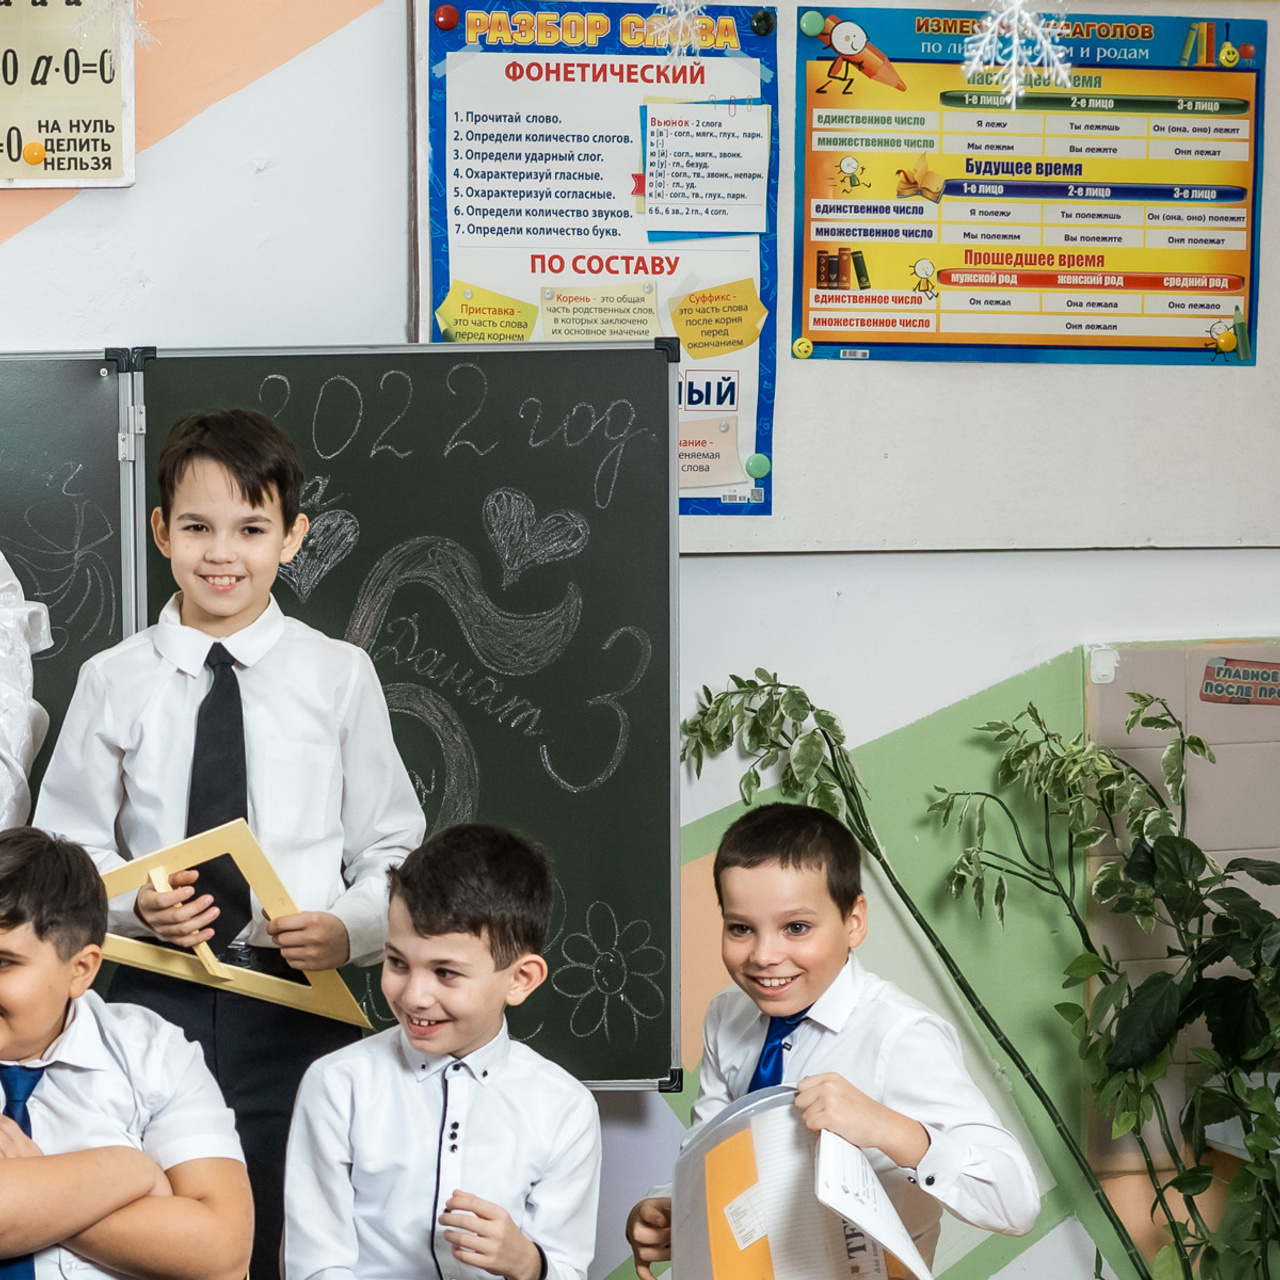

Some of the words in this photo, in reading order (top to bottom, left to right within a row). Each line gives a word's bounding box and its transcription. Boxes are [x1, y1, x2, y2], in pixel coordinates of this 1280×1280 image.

[465, 10, 610, 46] РАЗБОР
[1096, 45, 1150, 61] родам
[505, 60, 706, 86] ФОНЕТИЧЕСКИЙ
[1070, 97, 1087, 108] 2-е
[1088, 98, 1115, 110] лицо
[1177, 100, 1193, 111] 3-е
[1194, 101, 1220, 112] лицо
[454, 111, 464, 123] 1.
[465, 111, 521, 125] Прочитай
[525, 114, 562, 124] слово.
[650, 117, 690, 127] Вьюнок
[701, 120, 722, 128] слога
[817, 113, 892, 126] единственное
[894, 115, 926, 126] число
[38, 119, 62, 133] НА
[69, 119, 115, 133] НУЛЬ
[453, 130, 463, 142] 2.
[465, 130, 522, 144] Определи
[525, 132, 590, 143] количество
[592, 133, 633, 144] слогов.
[817, 136, 902, 148] множественное
[903, 138, 935, 149] число
[44, 138, 112, 154] ДЕЛИТЬ
[453, 149, 463, 161] 3.
[465, 149, 522, 163] Определи
[524, 150, 575, 164] ударный
[577, 152, 604, 162] слог.
[43, 157, 112, 171] НЕЛЬЗЯ
[965, 157, 1033, 176] Будущее
[1035, 162, 1083, 177] время
[453, 168, 463, 179] 4.
[465, 167, 552, 182] Охарактеризуй
[554, 171, 604, 181] гласные.
[453, 186, 463, 198] 5.
[465, 186, 552, 201] Охарактеризуй
[554, 190, 616, 200] согласные.
[962, 182, 977, 194] 1-е
[978, 183, 1004, 196] лицо
[454, 205, 464, 216] 6.
[466, 205, 522, 219] Определи
[525, 207, 589, 218] количество
[591, 208, 633, 221] звуков.
[815, 203, 891, 216] единственное
[892, 204, 924, 216] число
[454, 223, 465, 235] 7.
[467, 223, 523, 237] Определи
[525, 226, 590, 236] количество
[592, 224, 621, 239] букв.
[815, 226, 901, 238] множественное
[902, 228, 934, 239] число
[530, 254, 565, 274] ПО
[571, 254, 681, 276] СОСТАВУ
[964, 249, 1055, 267] Прошедшее
[1058, 253, 1105, 268] время
[951, 271, 997, 285] мужской
[997, 273, 1018, 286] род
[1057, 274, 1103, 285] женский
[1104, 275, 1124, 287] род
[1163, 275, 1208, 288] средний
[1209, 277, 1229, 289] род
[556, 294, 591, 304] Корень
[600, 296, 616, 304] это
[616, 294, 646, 305] общая
[688, 293, 731, 305] Суффикс
[814, 293, 890, 305] единственное
[891, 294, 923, 305] число
[460, 303, 515, 316] Приставка
[546, 306, 571, 314] часть
[572, 306, 630, 315] родственных
[632, 306, 655, 315] слов,
[678, 307, 694, 315] это
[695, 305, 720, 314] часть
[722, 305, 749, 313] слова
[452, 318, 470, 327] это
[471, 318, 498, 328] часть
[499, 320, 528, 329] слова
[561, 317, 598, 326] которых
[600, 317, 648, 326] заключено
[685, 318, 713, 327] после
[714, 316, 743, 325] корня
[812, 316, 898, 328] множественное
[899, 317, 931, 329] число
[454, 330, 486, 342] перед
[487, 331, 525, 342] корнем
[551, 328, 562, 336] их
[564, 328, 606, 336] основное
[608, 328, 650, 336] значение
[700, 328, 729, 338] перед
[687, 339, 744, 350] окончанием
[518, 396, 644, 509] год
[1215, 666, 1279, 683] ГЛАВНОЕ
[1203, 681, 1253, 698] ПОСЛЕ
